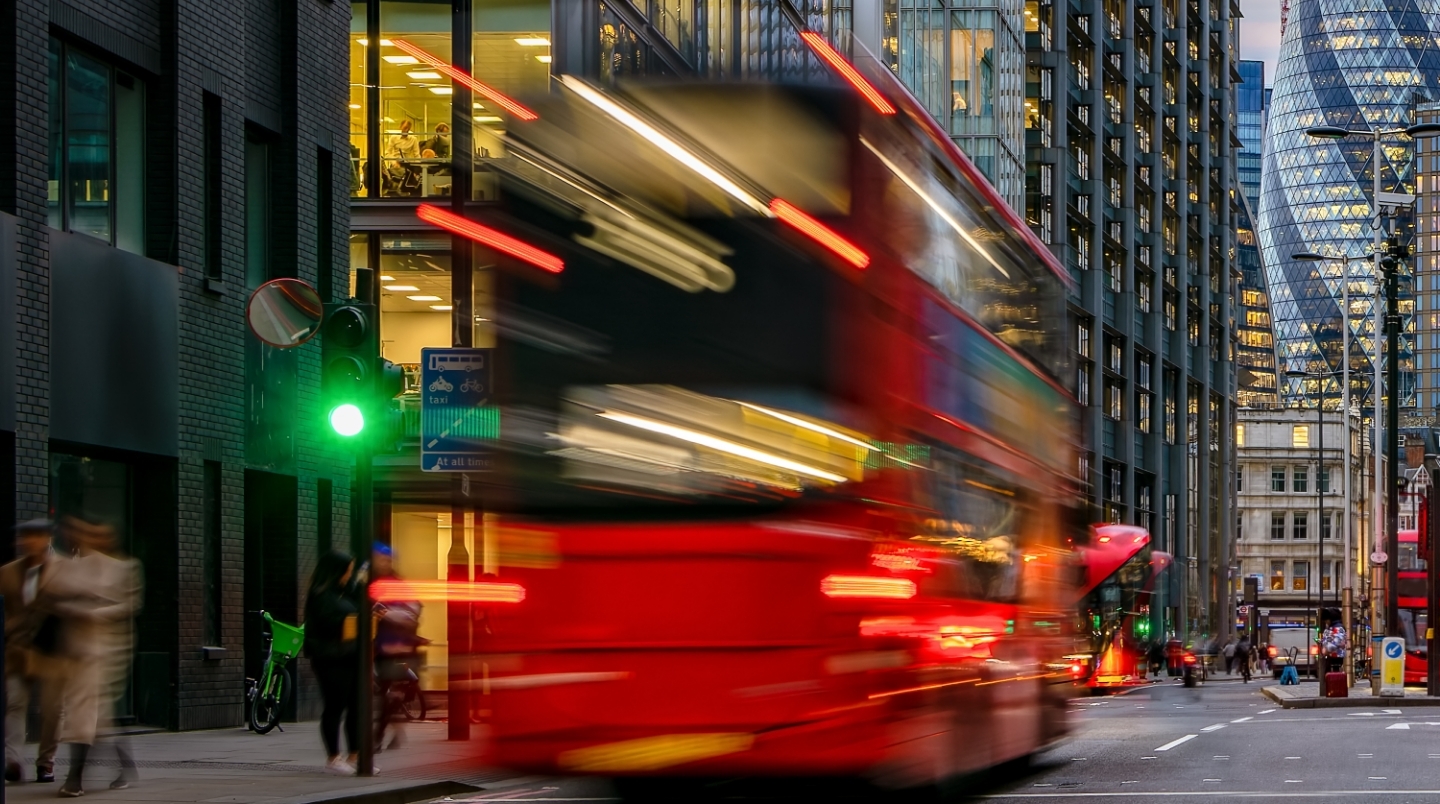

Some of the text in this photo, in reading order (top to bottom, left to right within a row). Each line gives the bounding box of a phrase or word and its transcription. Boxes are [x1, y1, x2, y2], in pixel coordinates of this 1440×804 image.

[429, 396, 448, 404] taxi
[437, 457, 448, 466] At
[451, 457, 464, 466] all
